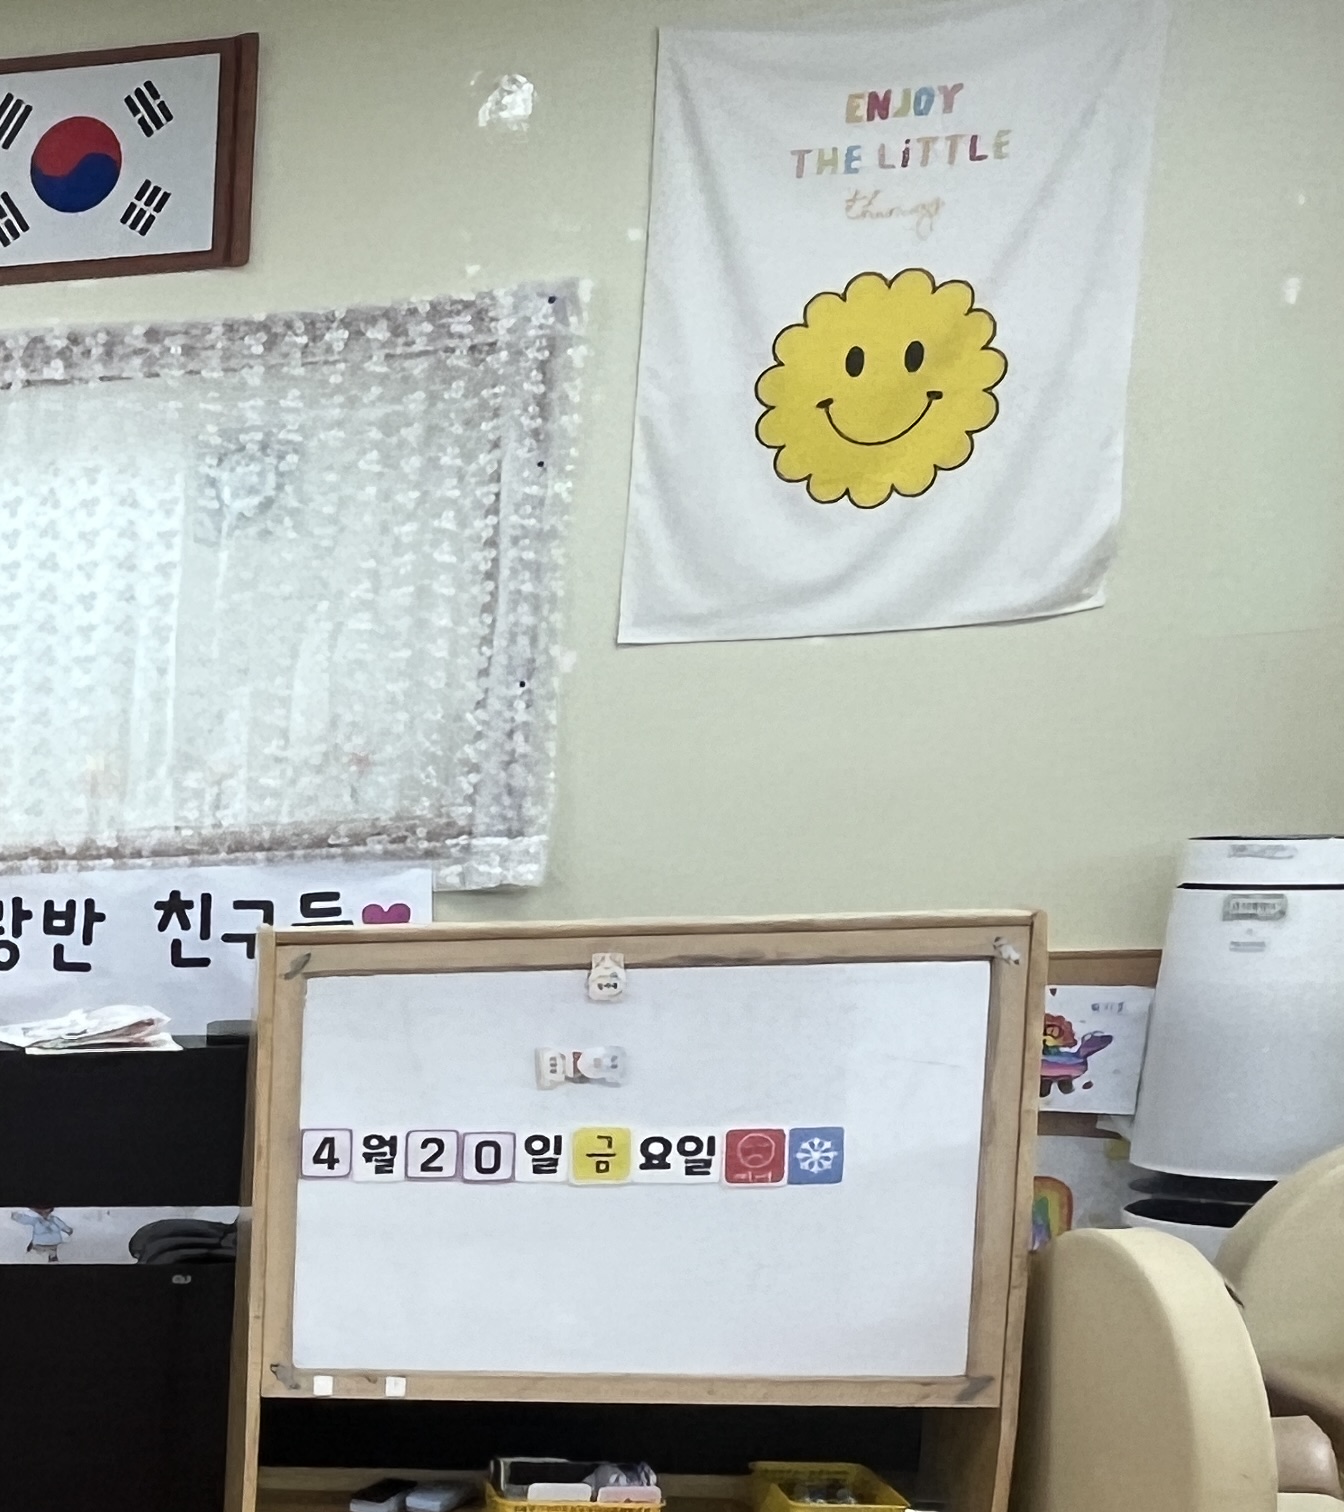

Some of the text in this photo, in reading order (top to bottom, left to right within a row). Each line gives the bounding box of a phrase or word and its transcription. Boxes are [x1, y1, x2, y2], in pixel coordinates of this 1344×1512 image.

[845, 83, 964, 124] ENJOY
[790, 145, 862, 179] THE
[312, 1134, 398, 1175] 4월
[585, 1134, 716, 1176] 금요일
